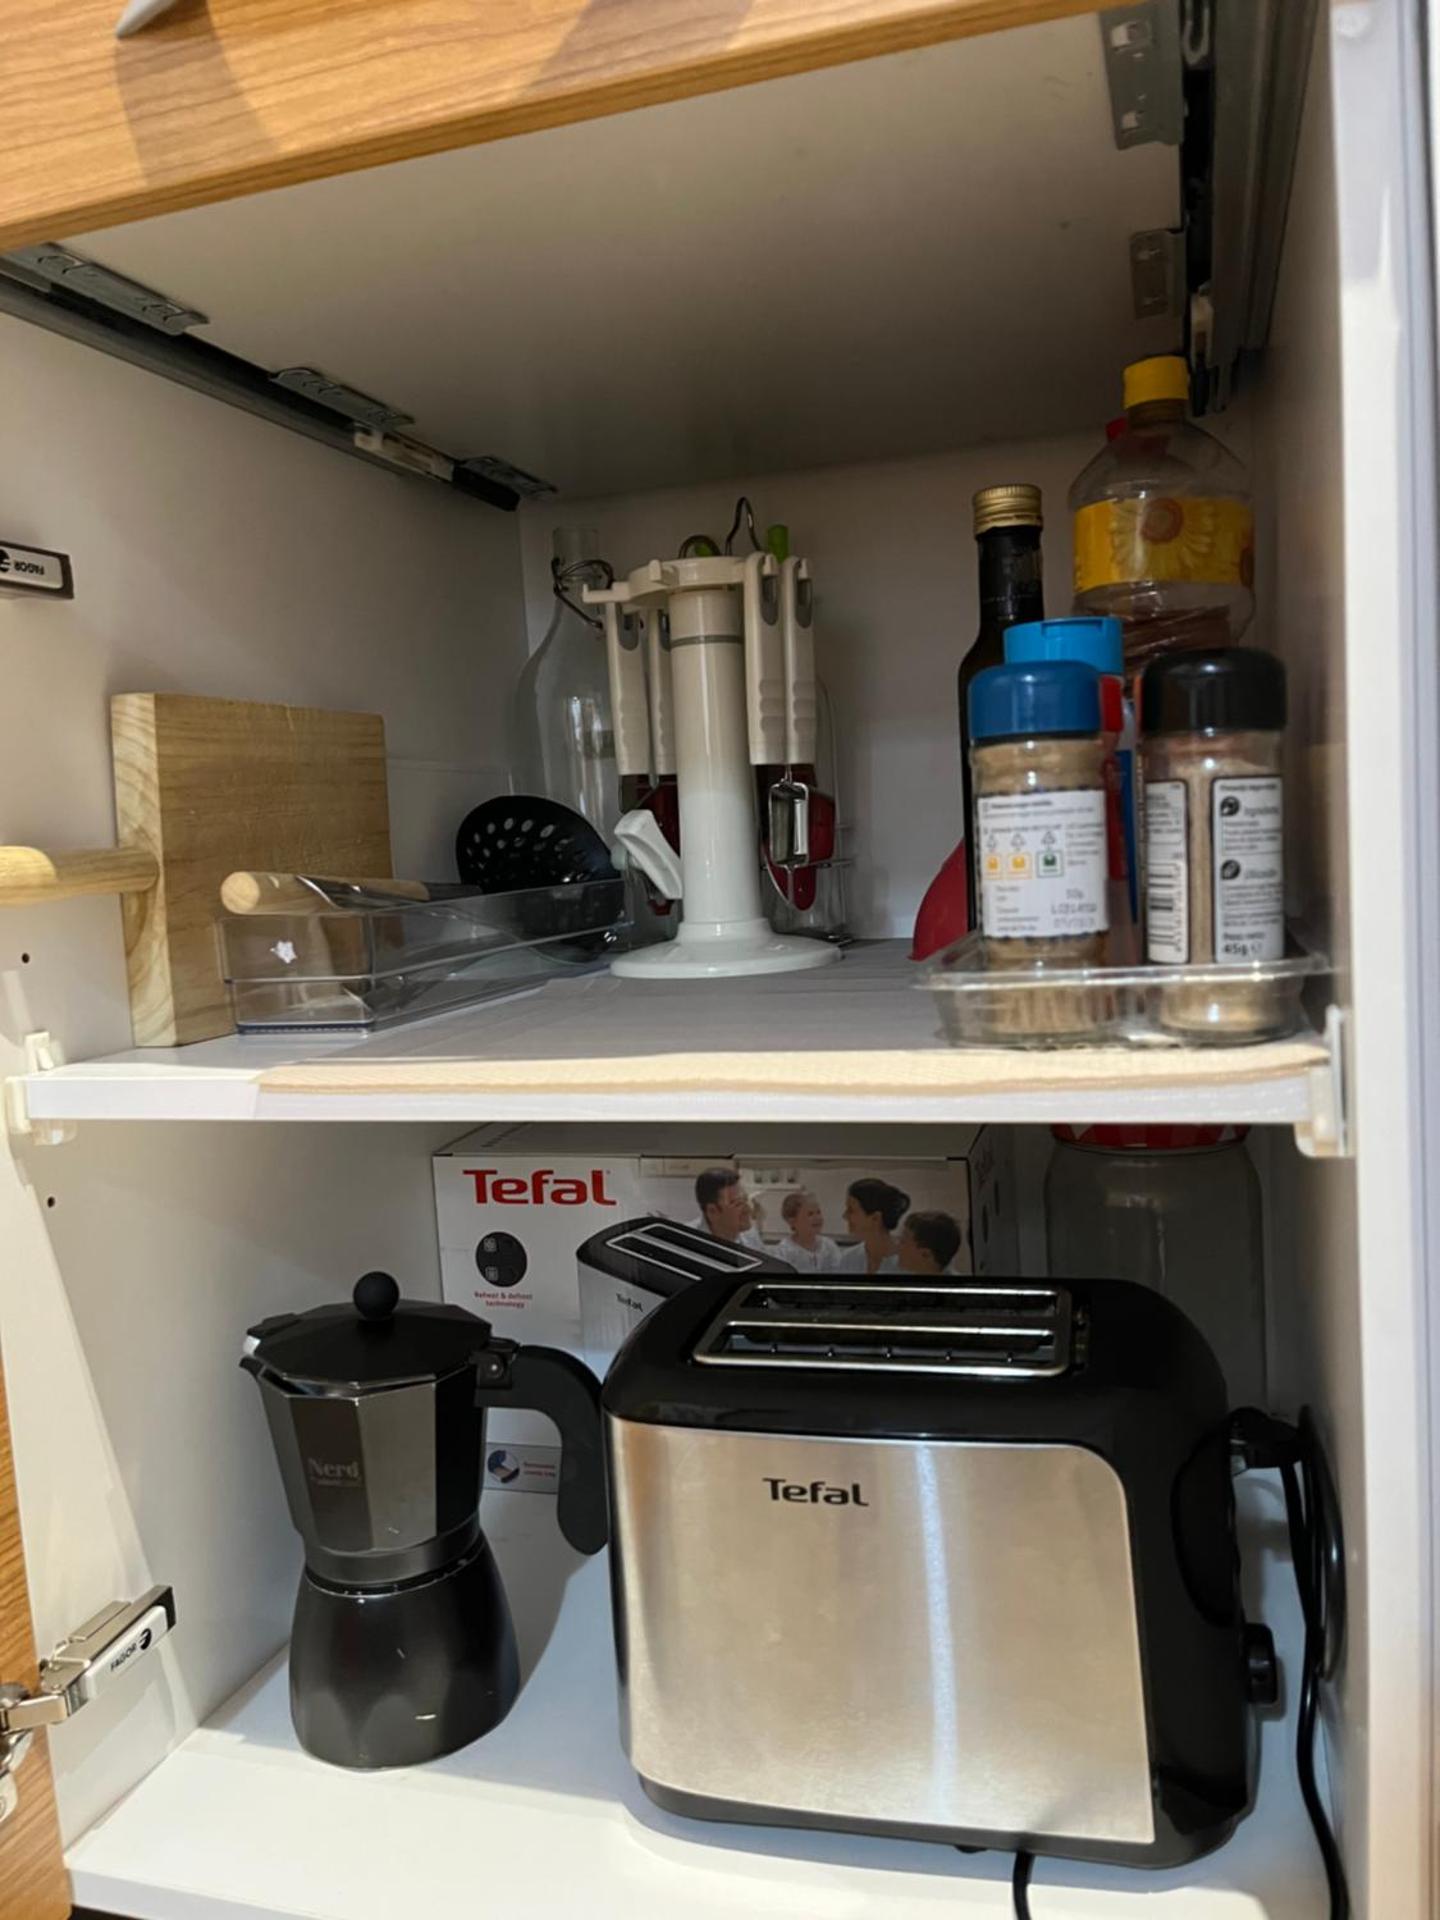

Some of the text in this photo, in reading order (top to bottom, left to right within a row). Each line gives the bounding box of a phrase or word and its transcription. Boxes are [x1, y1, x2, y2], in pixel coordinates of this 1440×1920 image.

[13, 560, 45, 575] FAGOR
[462, 1168, 617, 1206] Tefal
[306, 1456, 360, 1479] Nerd
[761, 1477, 870, 1508] Tefal
[110, 1643, 137, 1670] FAGOR
